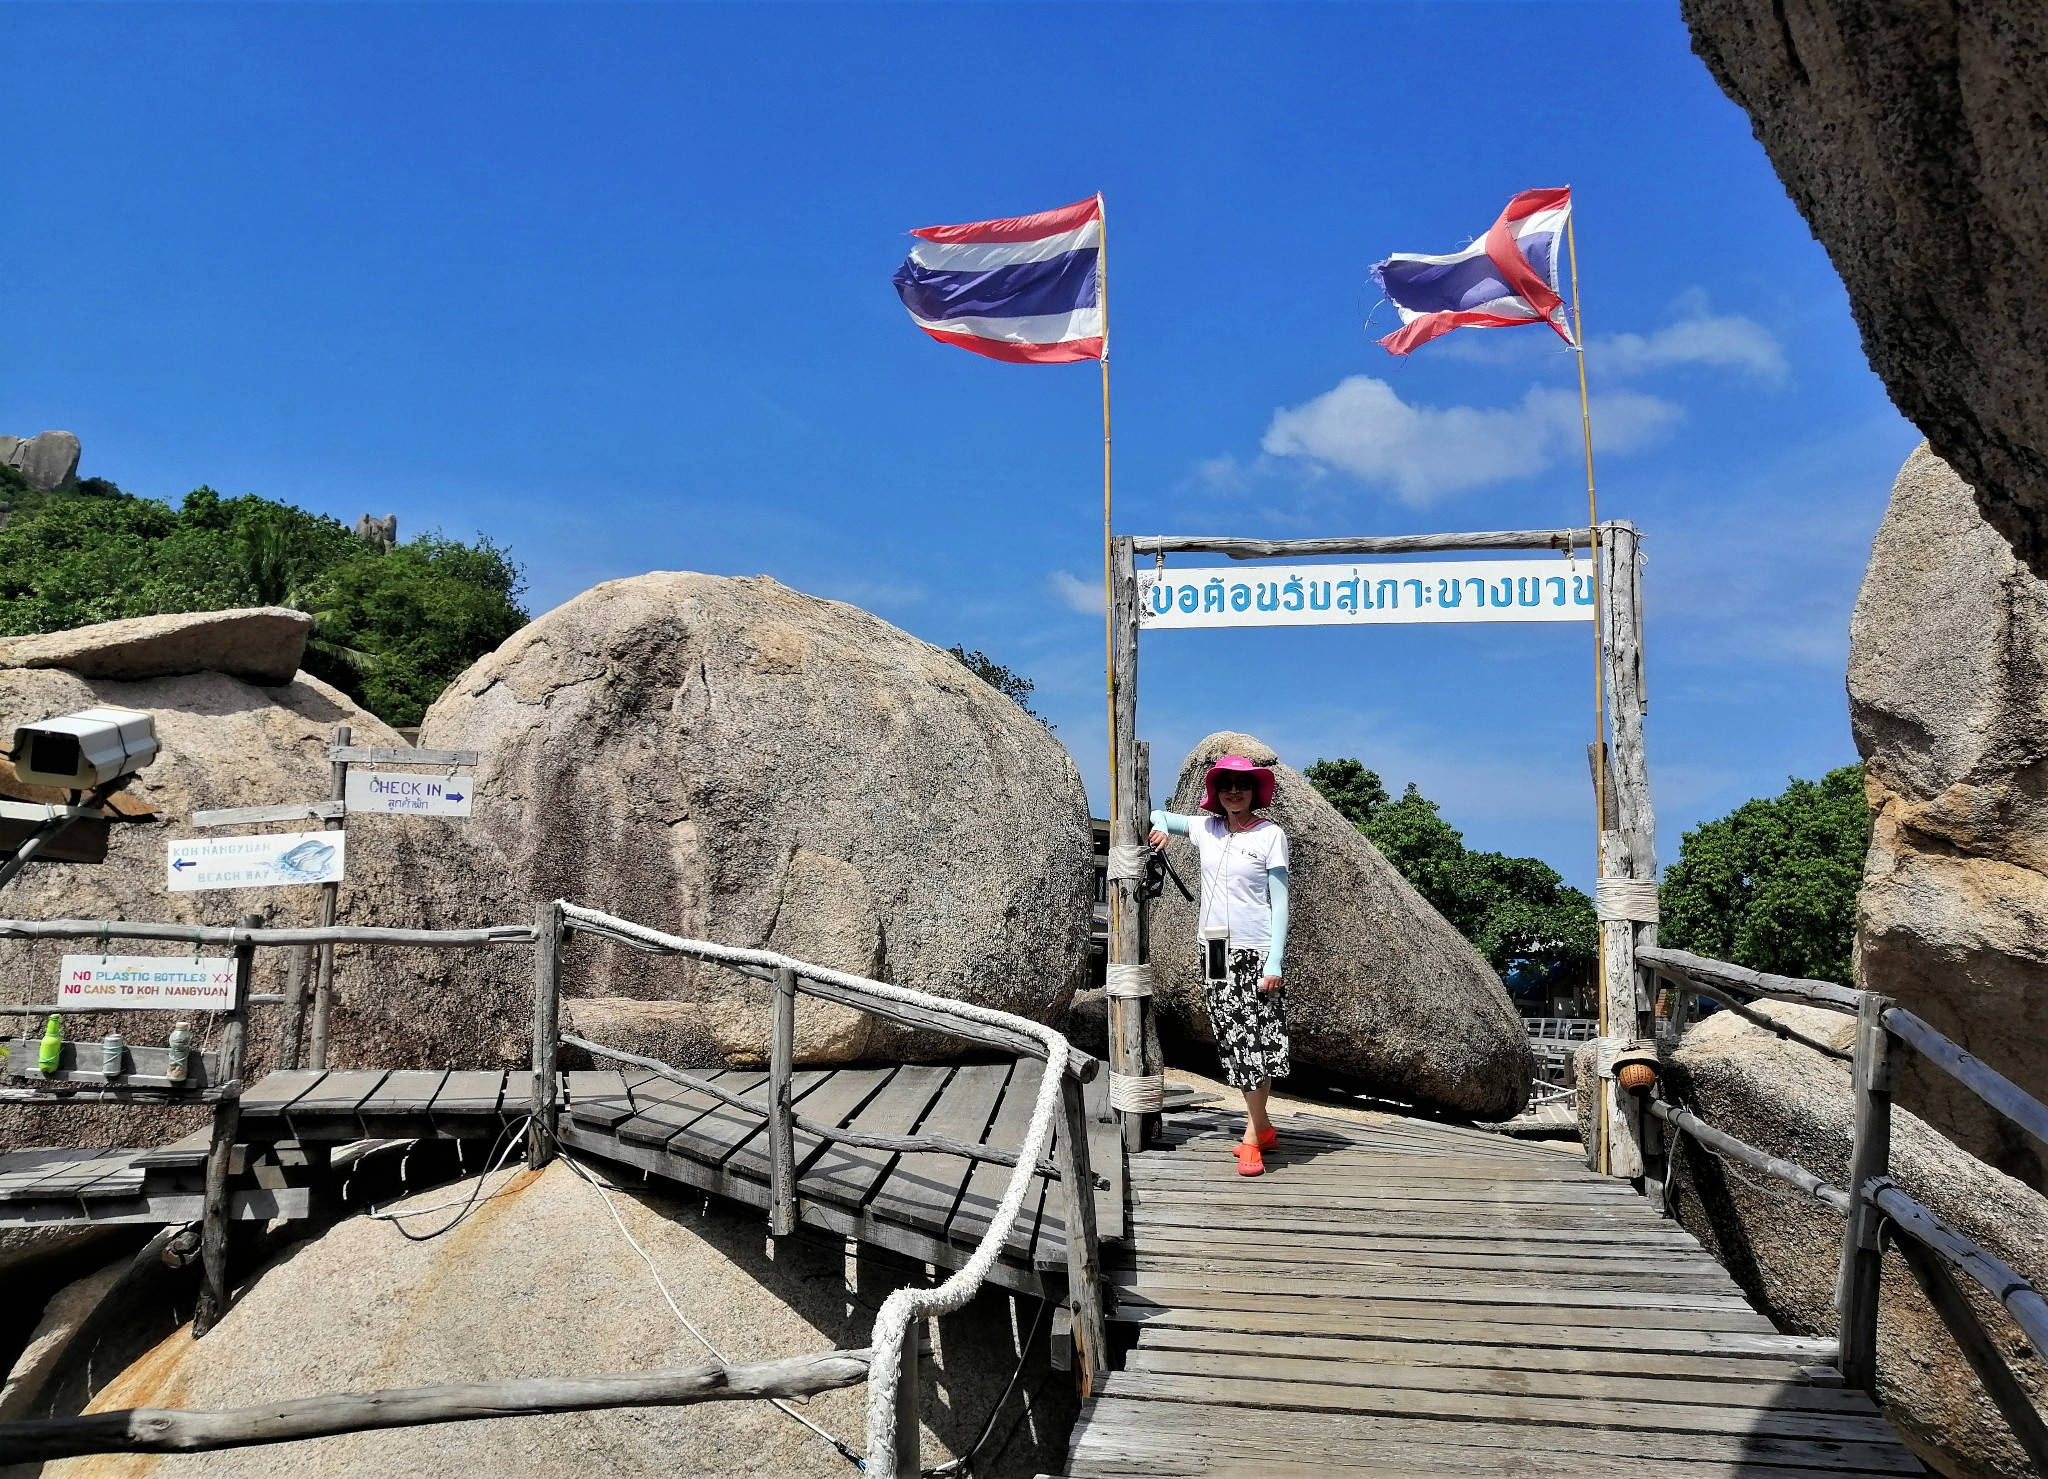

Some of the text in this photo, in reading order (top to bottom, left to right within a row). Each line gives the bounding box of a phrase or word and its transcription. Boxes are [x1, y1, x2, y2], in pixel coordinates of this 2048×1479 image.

[369, 780, 442, 796] CHECK IN
[173, 847, 198, 857] KOH
[198, 869, 269, 883] BEACH WAY
[73, 971, 91, 981] NO
[96, 971, 150, 981] PLASTIC
[154, 972, 207, 982] BOTTLES
[64, 984, 228, 997] NO CANS TO KOH NANGYUAN
